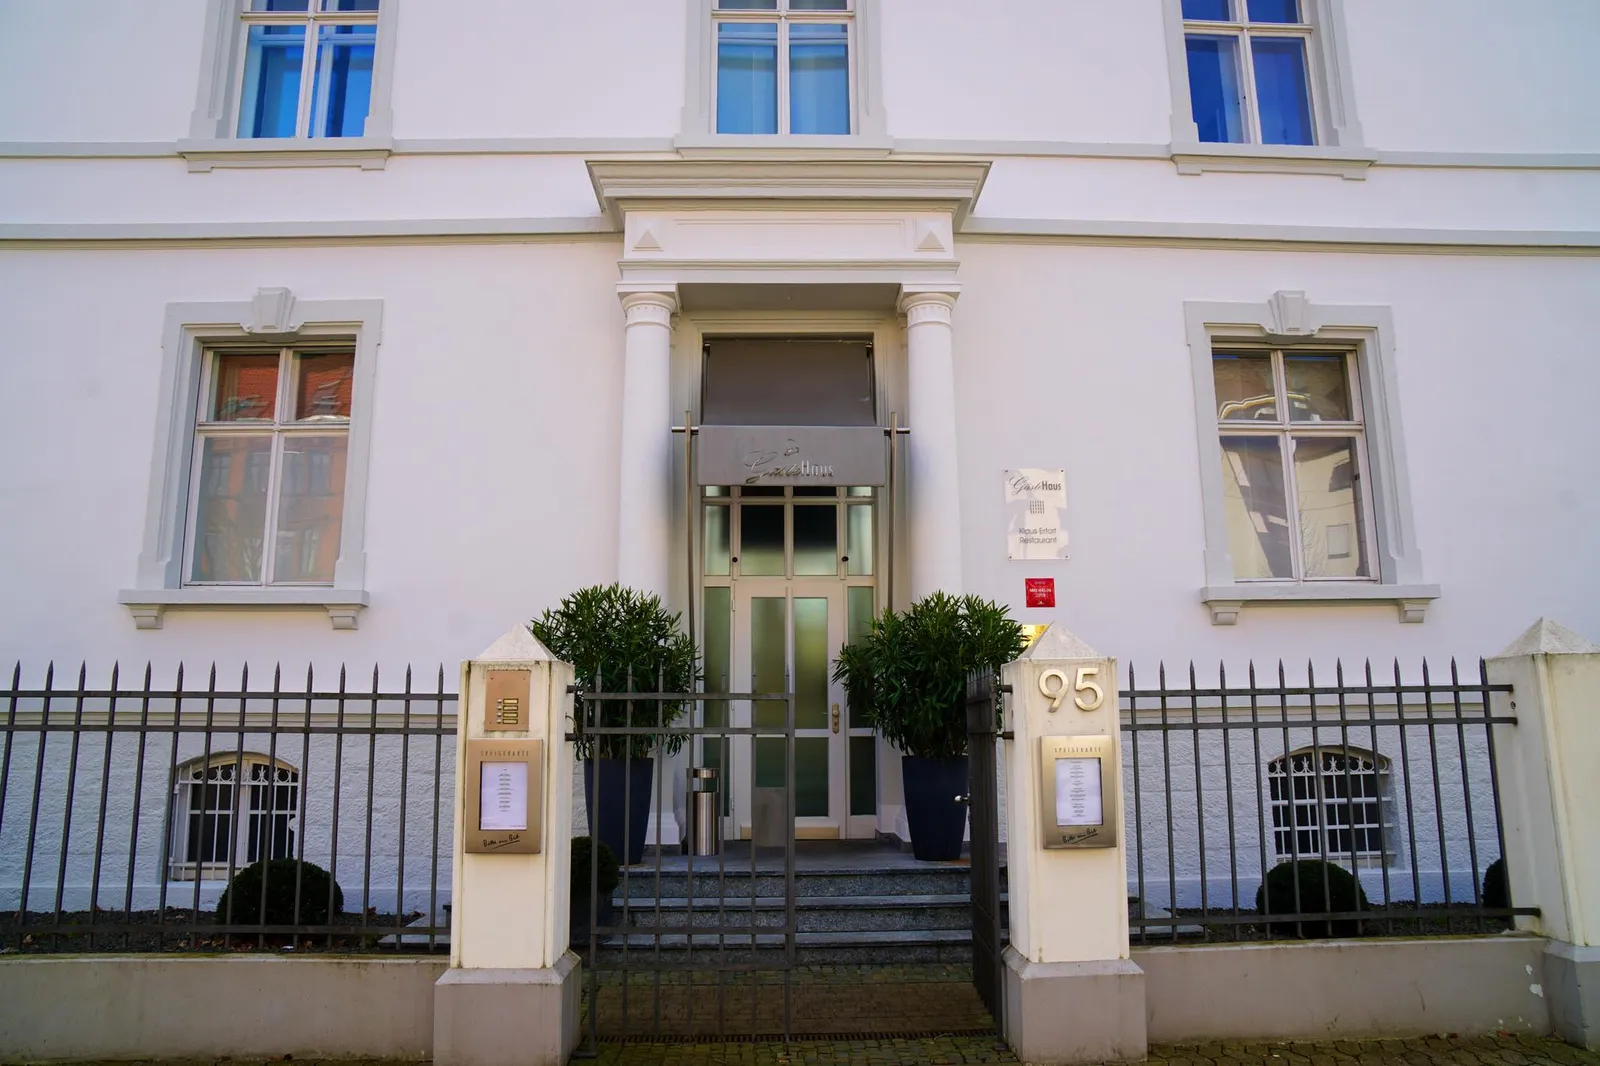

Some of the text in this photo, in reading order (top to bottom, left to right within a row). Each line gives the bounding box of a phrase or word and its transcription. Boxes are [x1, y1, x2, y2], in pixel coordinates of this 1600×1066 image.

[1018, 527, 1038, 535] Klaus
[1019, 536, 1057, 544] Restaurant
[1038, 667, 1104, 713] 95
